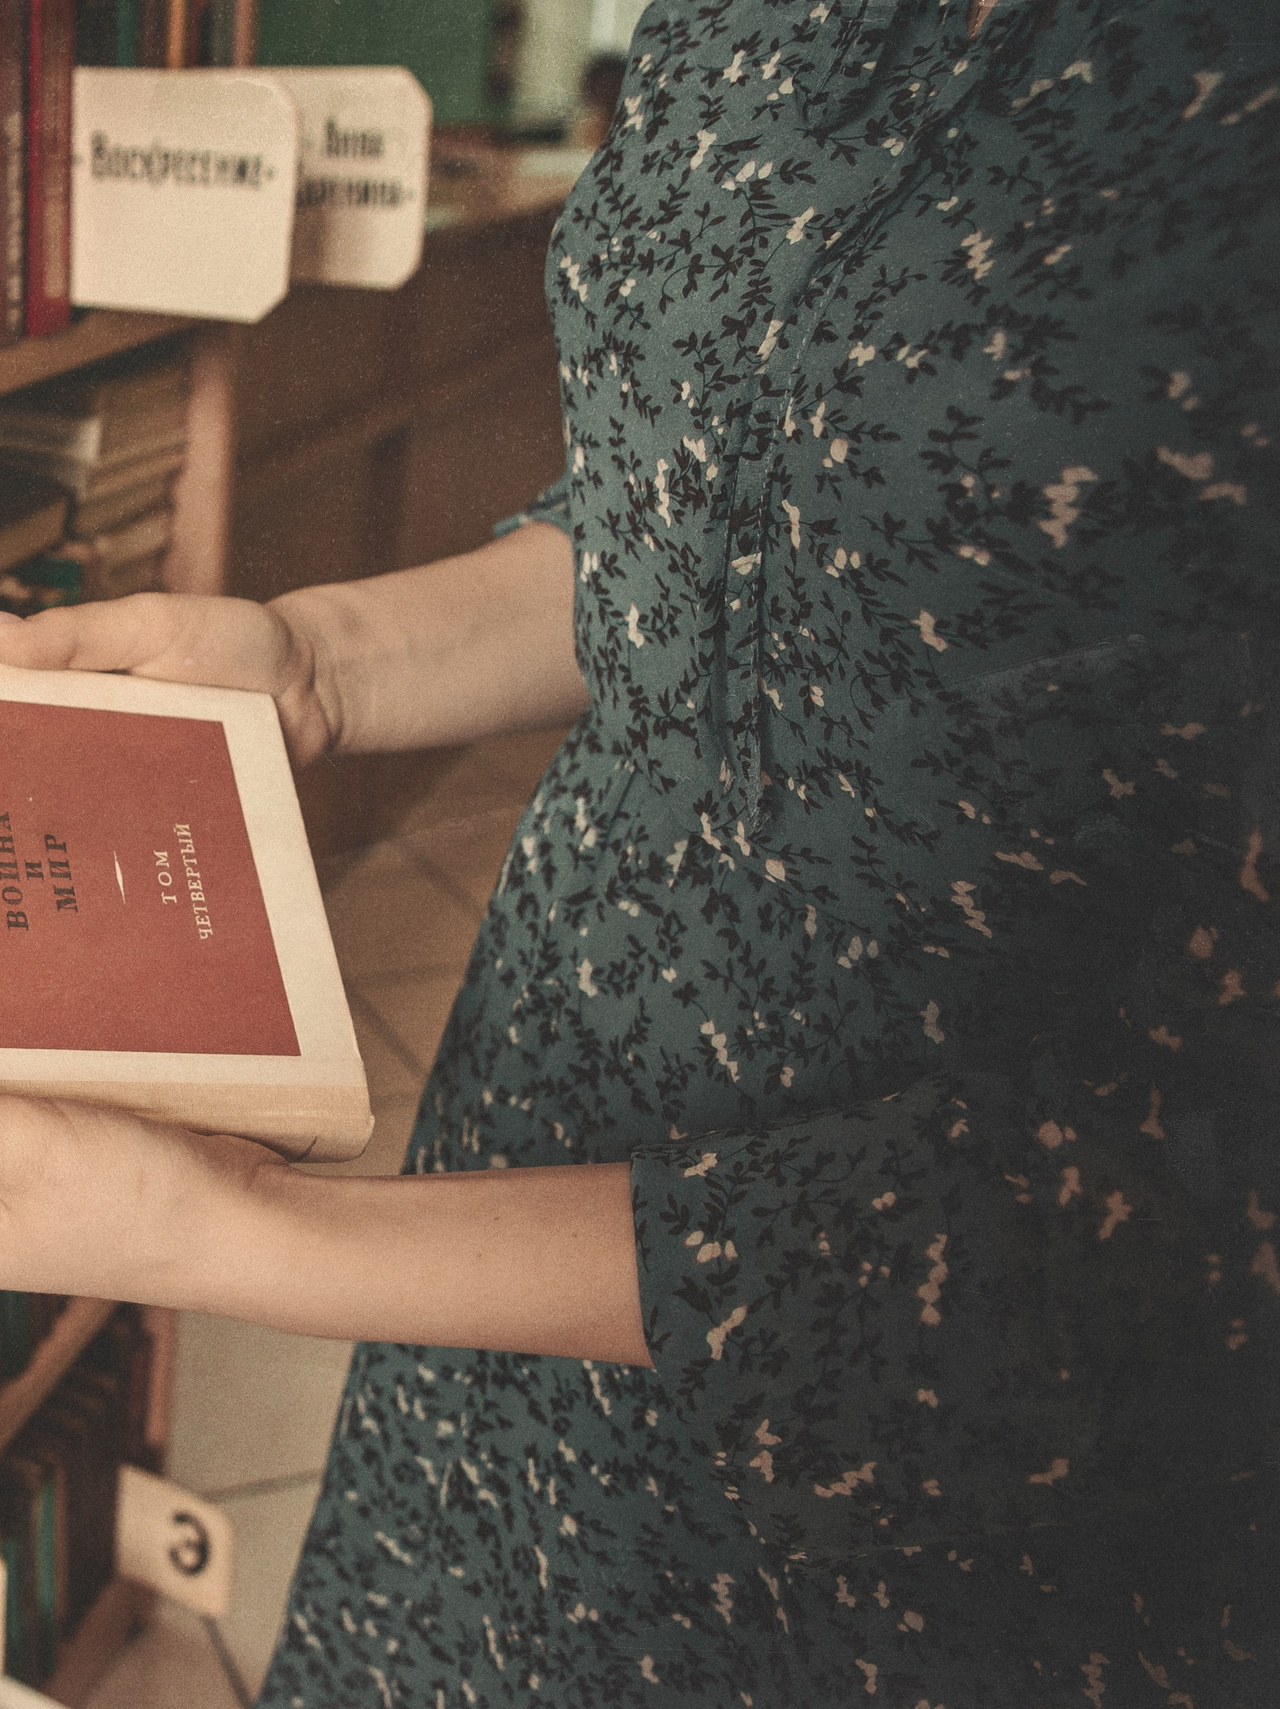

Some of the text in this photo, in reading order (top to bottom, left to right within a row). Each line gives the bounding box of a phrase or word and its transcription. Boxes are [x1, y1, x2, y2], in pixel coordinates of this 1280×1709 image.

[25, 859, 45, 881] И
[44, 833, 79, 913] МИР
[153, 849, 178, 904] ТОМ
[173, 822, 214, 940] ЧЕТВЕРТЫЙ
